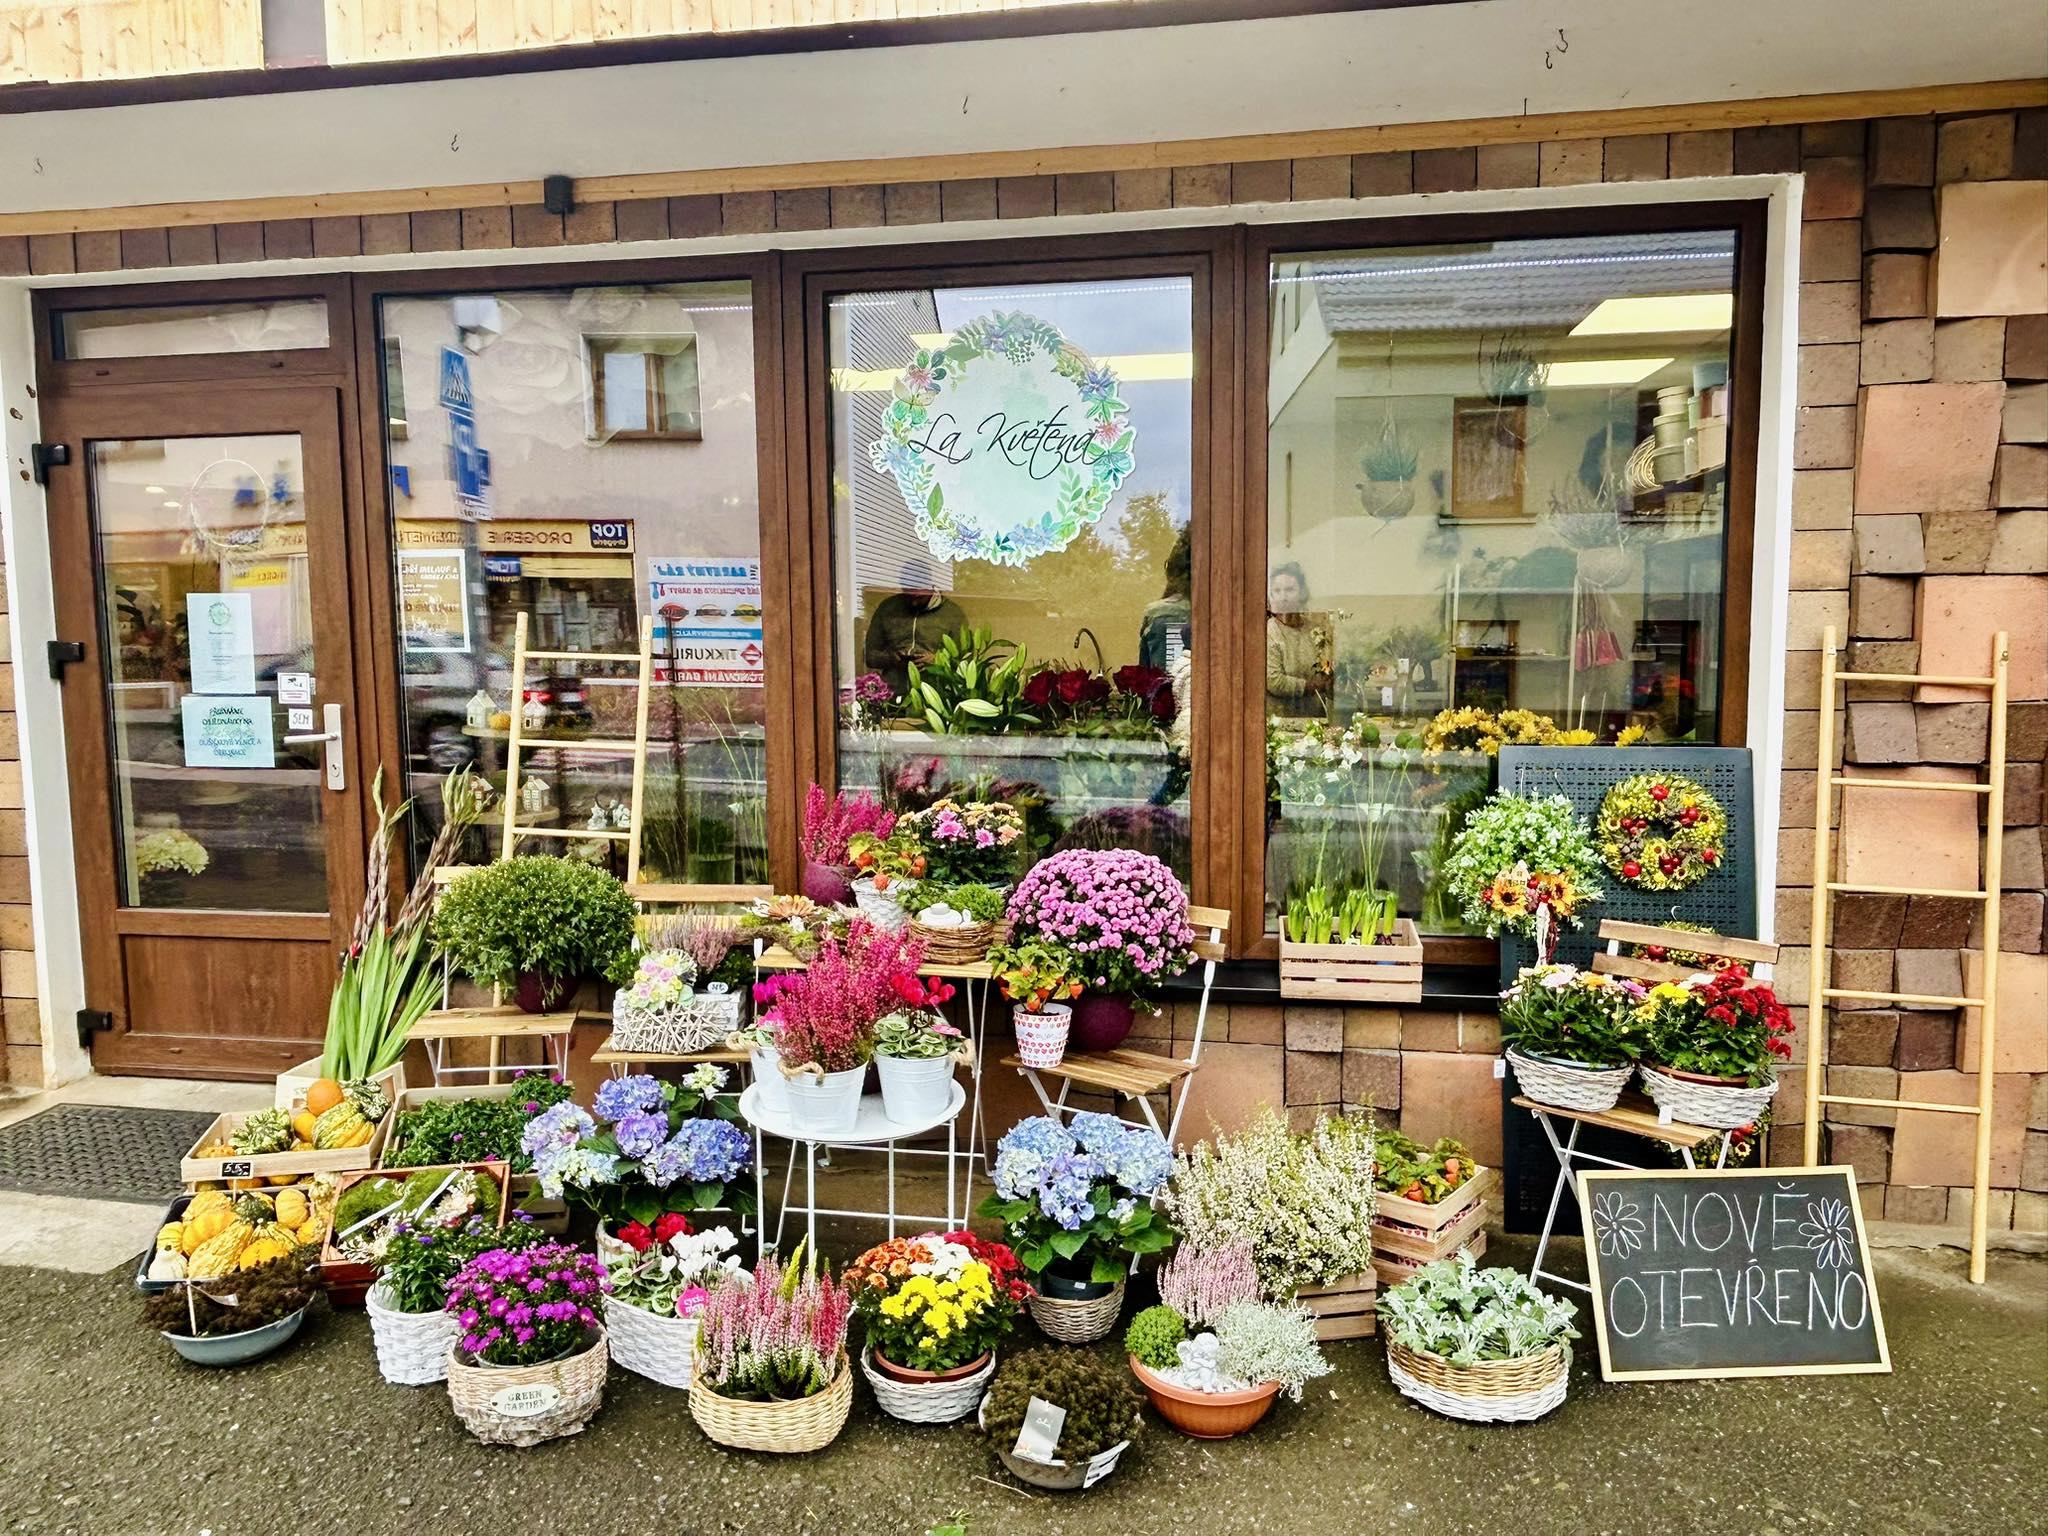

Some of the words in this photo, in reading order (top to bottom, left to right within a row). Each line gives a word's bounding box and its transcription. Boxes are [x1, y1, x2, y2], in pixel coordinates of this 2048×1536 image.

[908, 413, 974, 465] La
[977, 405, 1109, 480] Květena
[1653, 1181, 1810, 1253] NOVĚ
[1609, 1258, 1868, 1338] OTEVŘENO
[503, 1399, 547, 1412] GARDEN
[507, 1389, 543, 1402] GREEN
